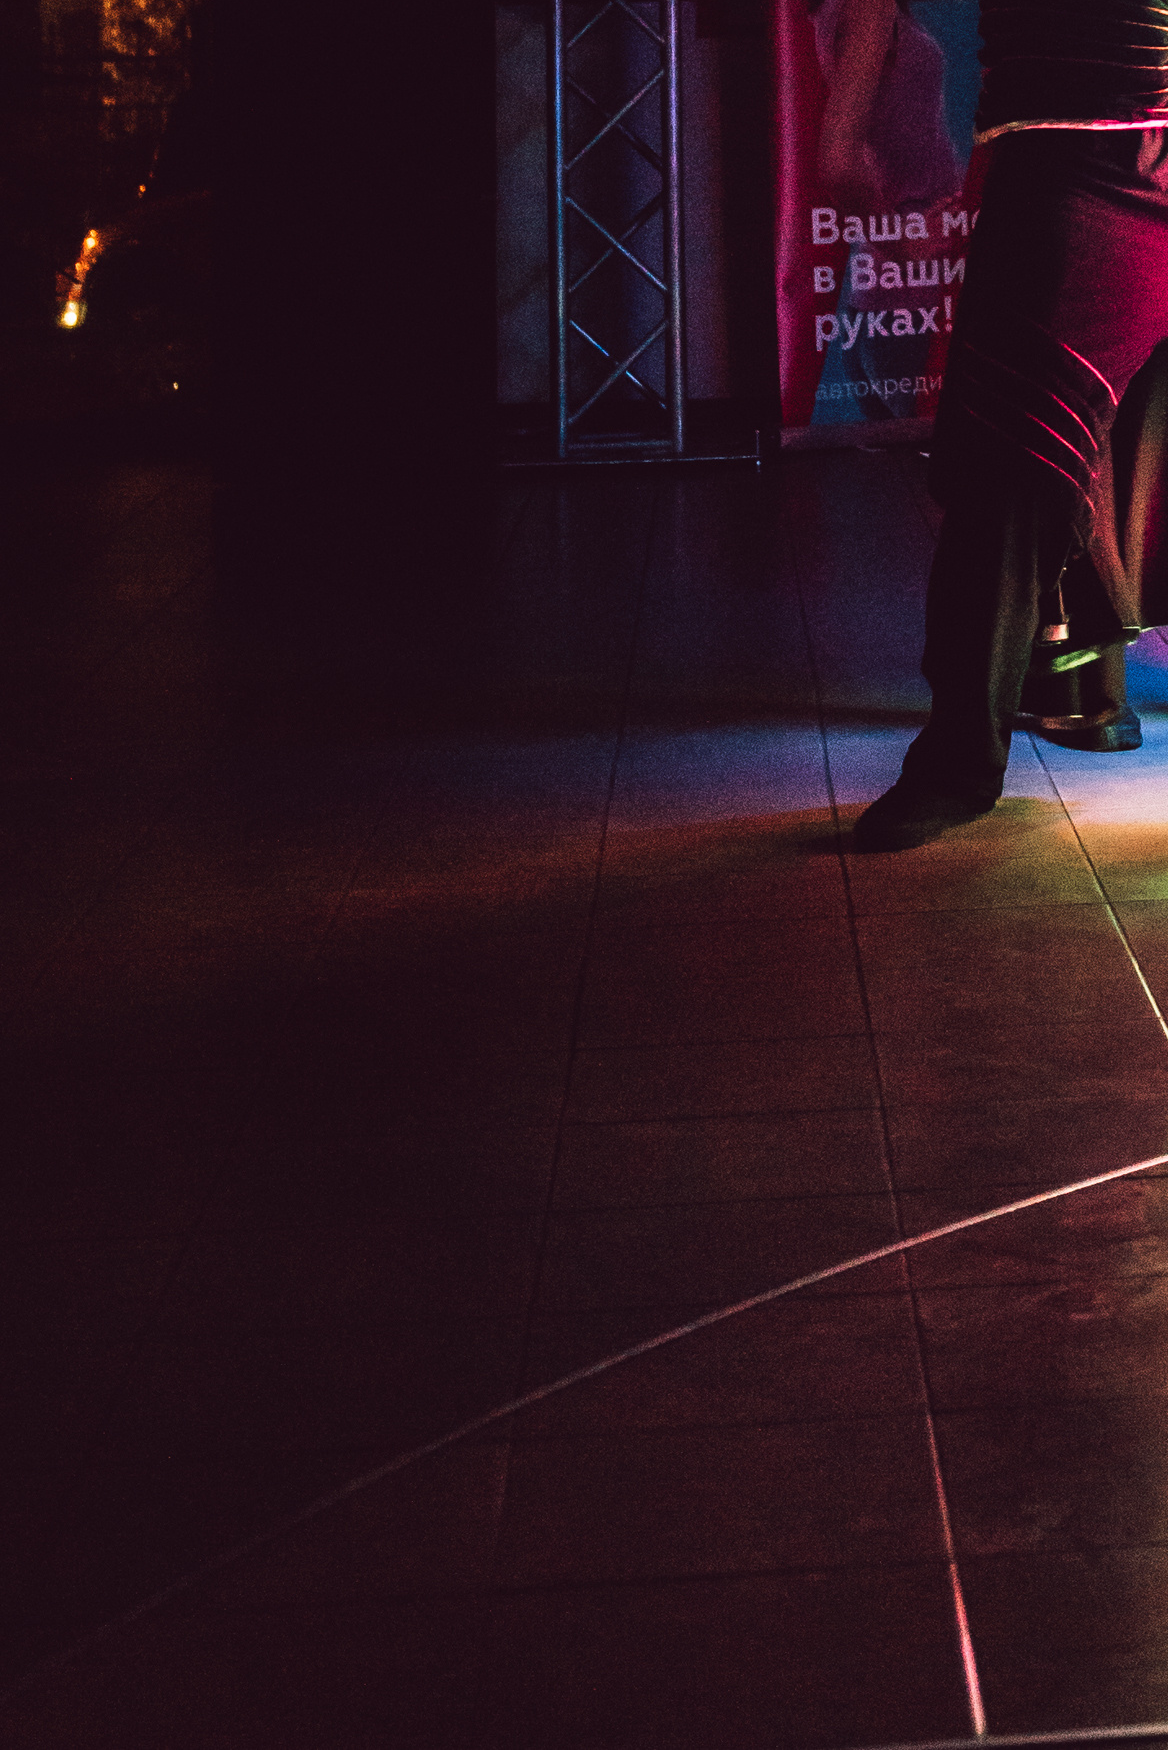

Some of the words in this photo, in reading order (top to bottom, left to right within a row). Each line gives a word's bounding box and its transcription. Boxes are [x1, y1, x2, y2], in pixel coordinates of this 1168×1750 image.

[811, 206, 930, 246] Ваша
[812, 265, 837, 293] в
[850, 252, 966, 293] Ваши
[815, 295, 954, 351] руках!
[815, 374, 944, 401] автокреди
